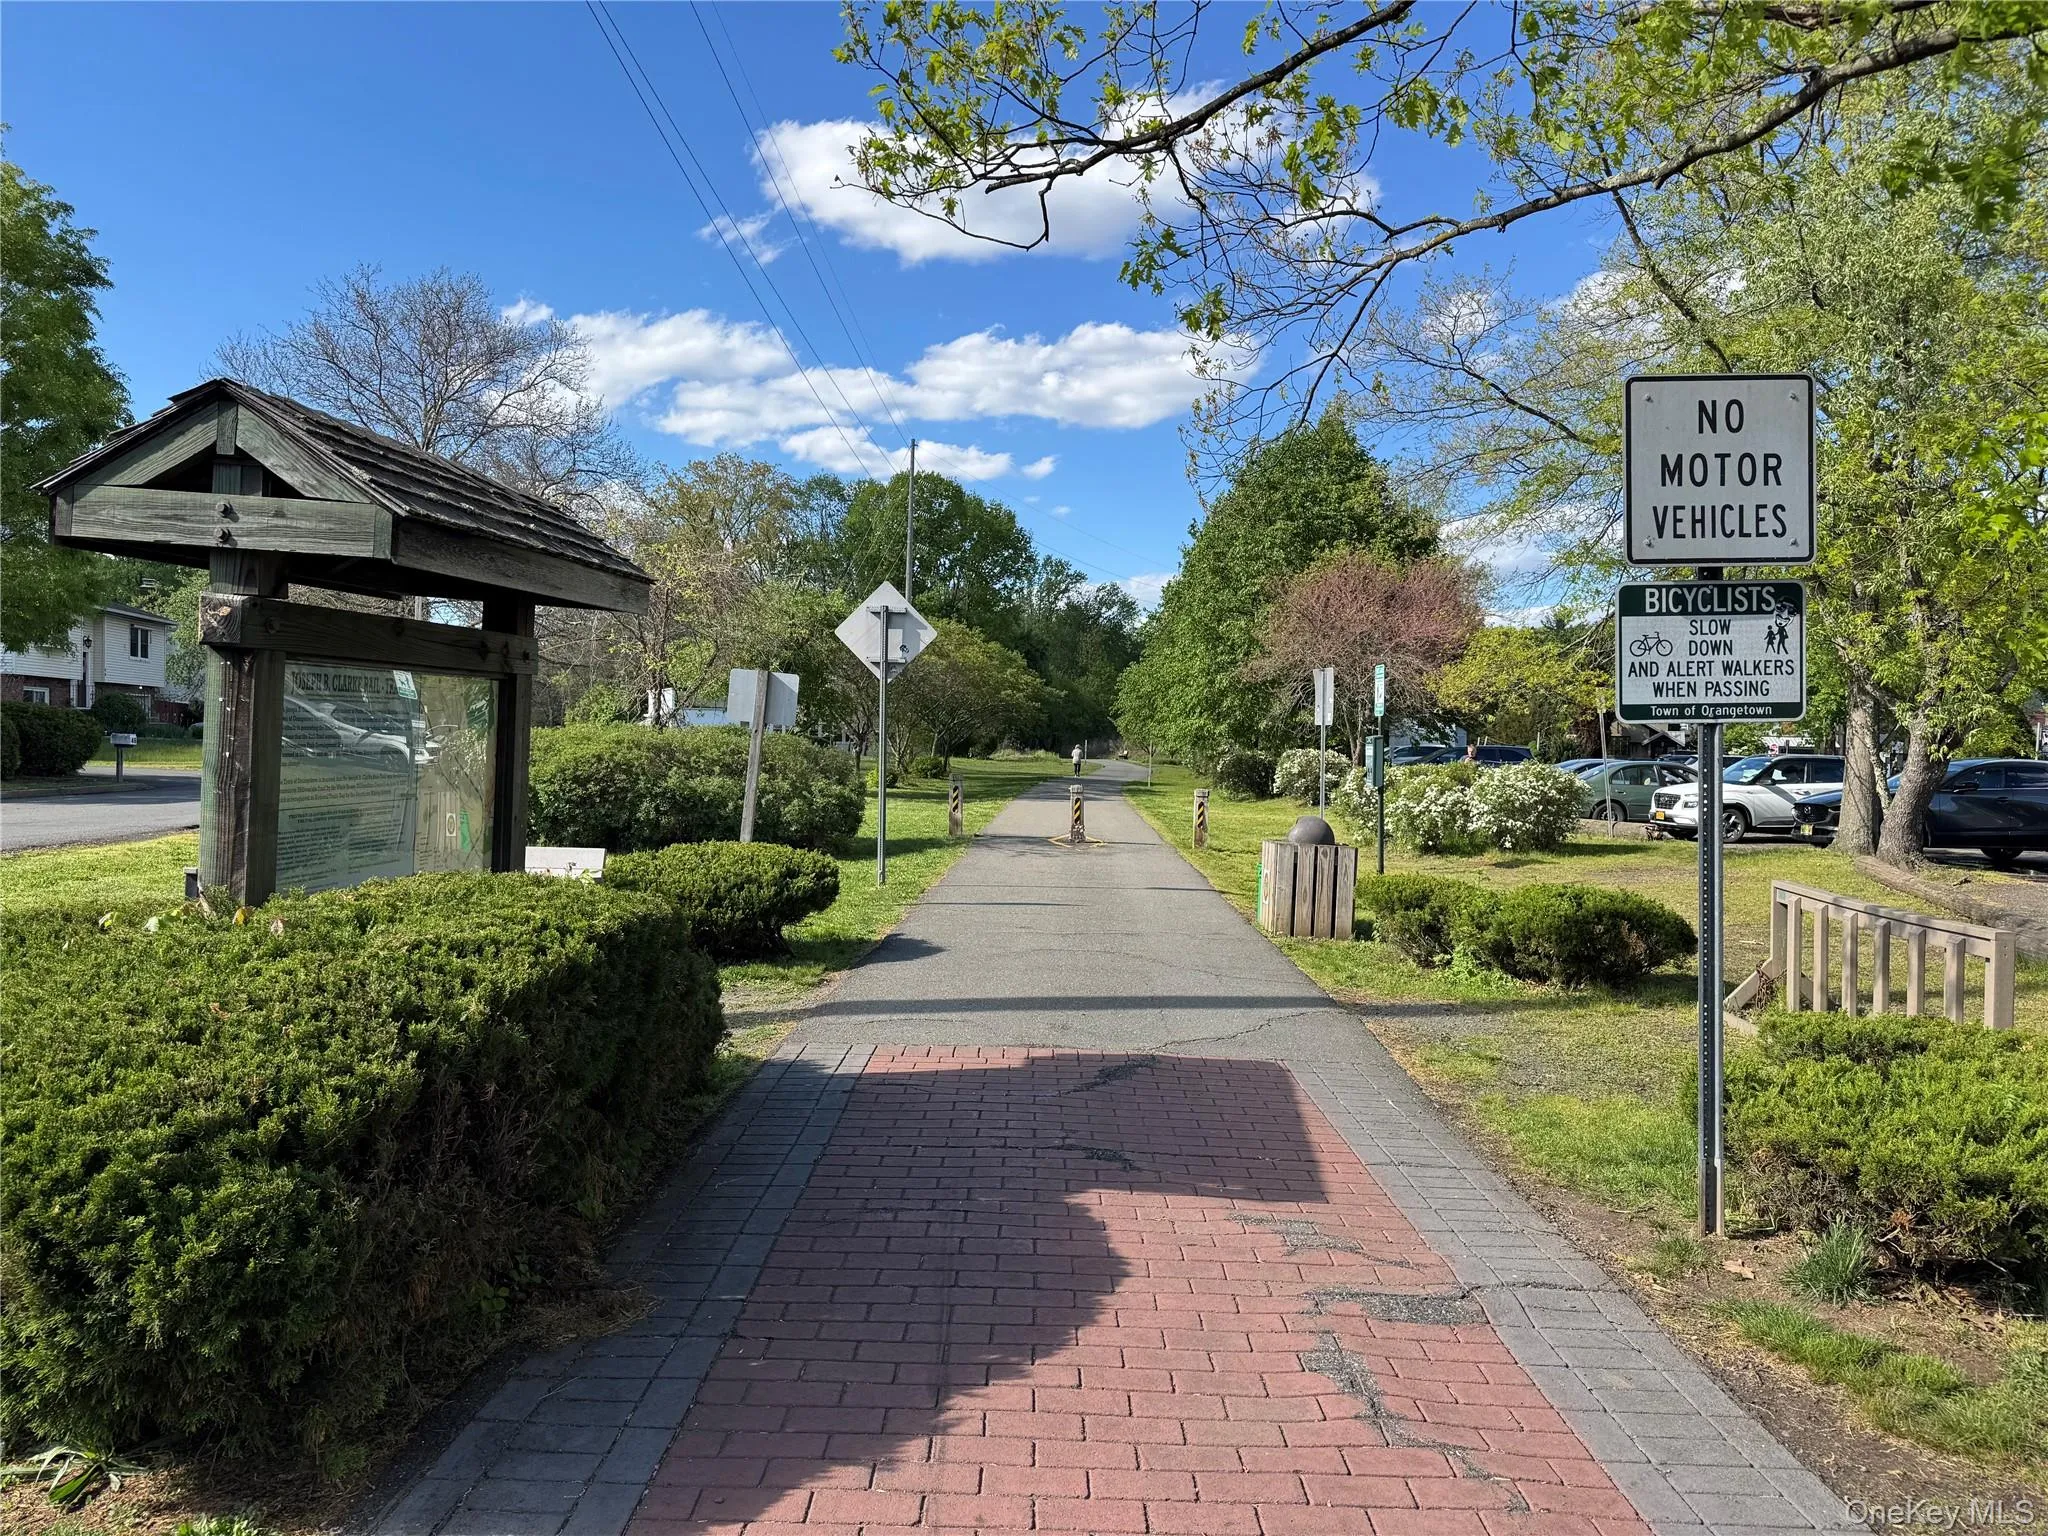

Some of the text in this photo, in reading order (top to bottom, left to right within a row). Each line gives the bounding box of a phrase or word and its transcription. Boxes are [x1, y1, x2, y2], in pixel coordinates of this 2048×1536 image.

[1698, 399, 1744, 434] NO
[1660, 452, 1782, 487] MOTOR
[1652, 503, 1787, 539] VEHICLES
[1645, 585, 1776, 613] BICYCLISTS
[1689, 619, 1732, 636] SLOW
[1689, 639, 1733, 656] DOWN
[1628, 659, 1795, 678] AND ALERT WALKERS
[291, 671, 322, 695] JOSEPH
[1652, 680, 1770, 698] WHEN PASSING
[1650, 705, 1772, 718] Town of Orangetown
